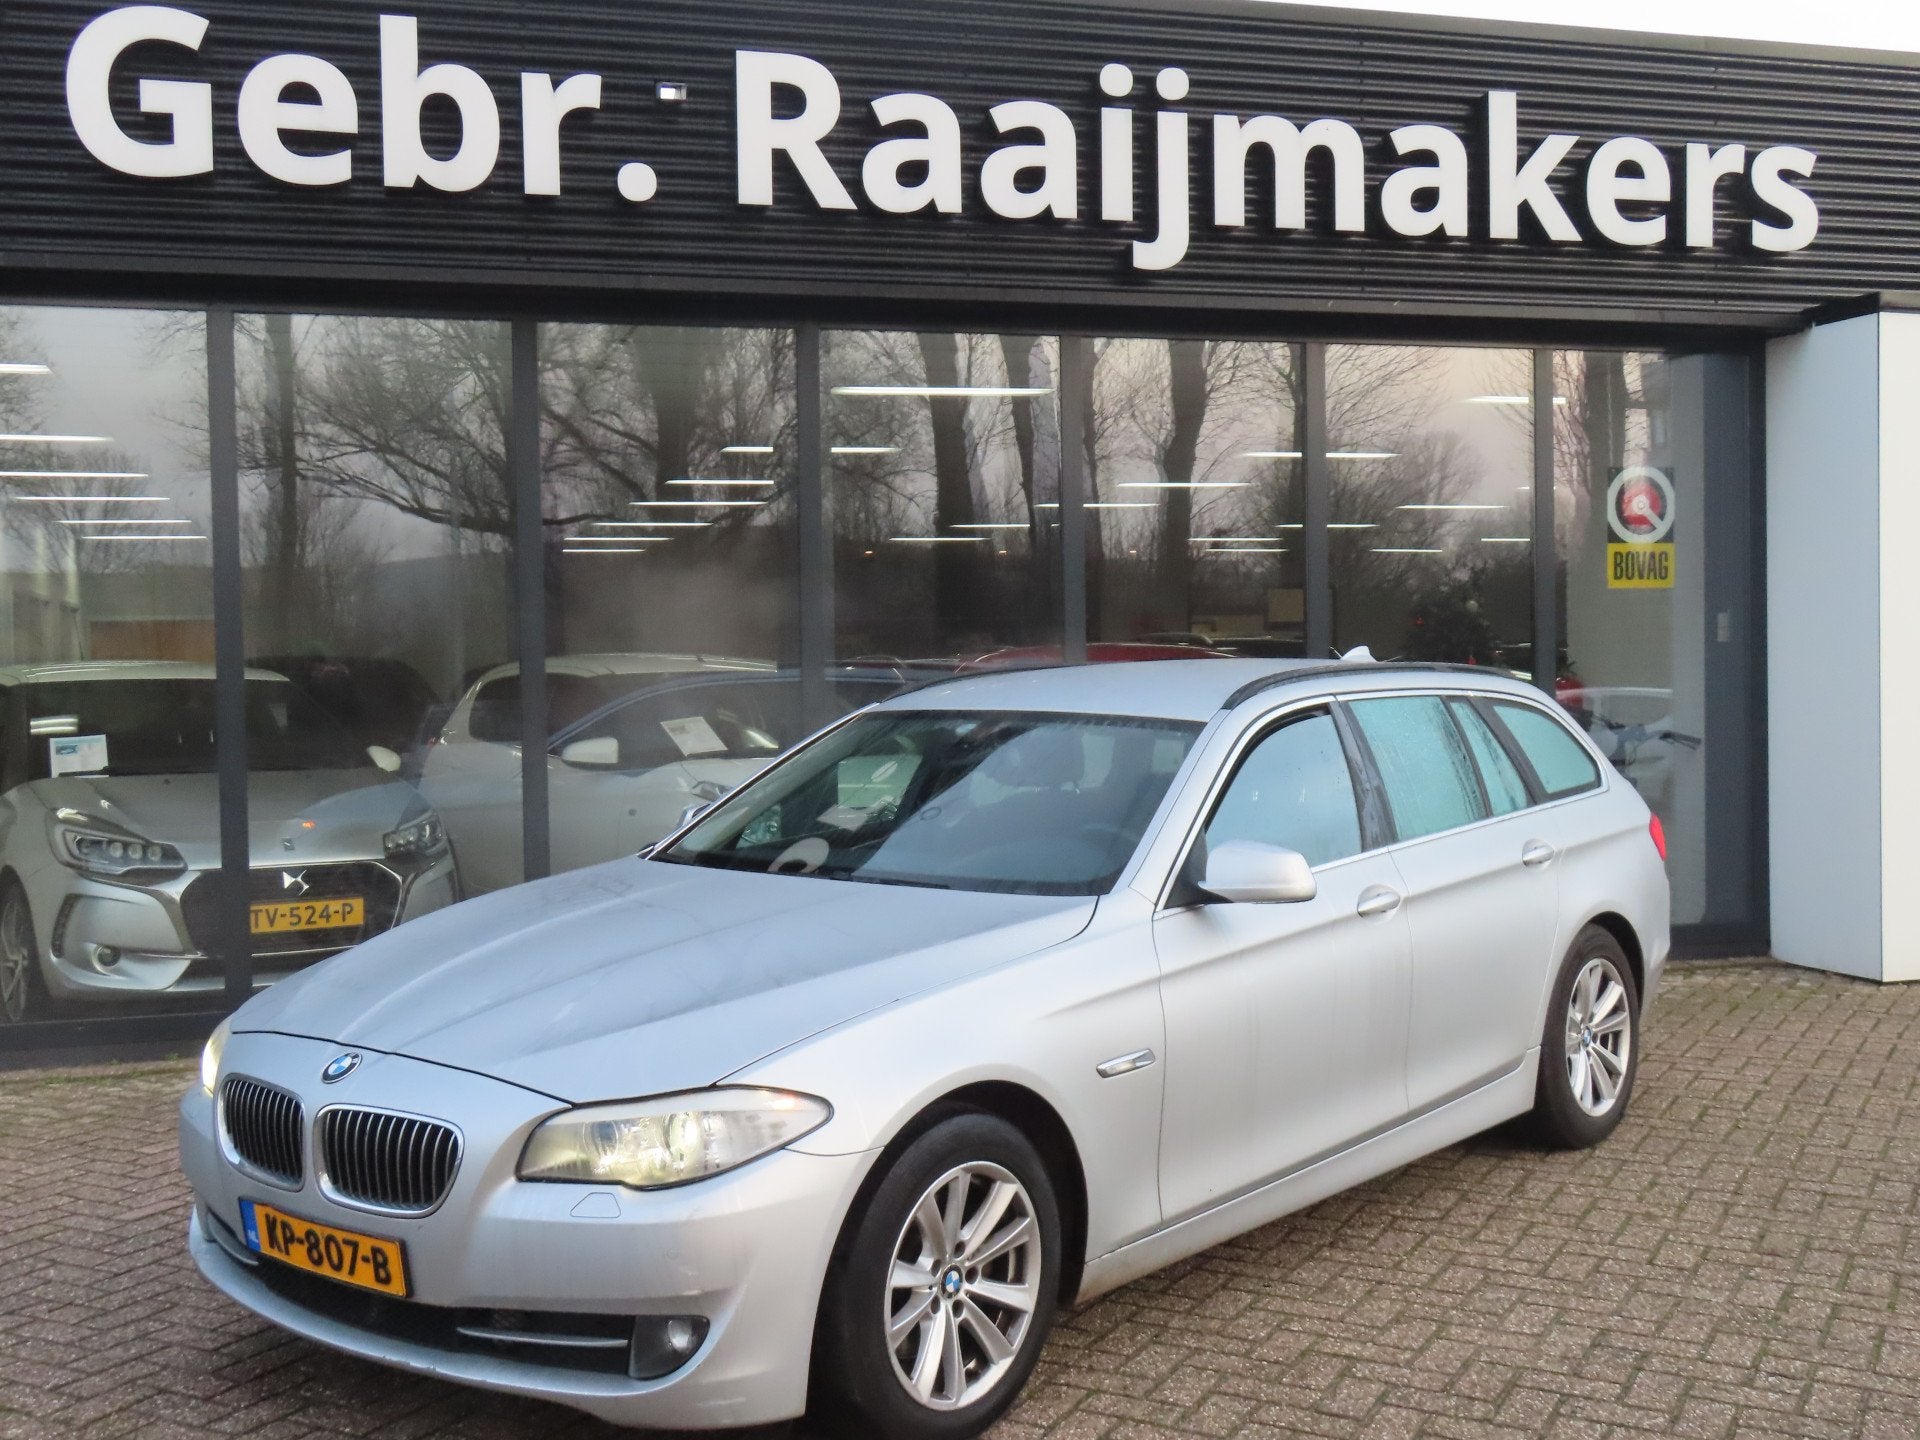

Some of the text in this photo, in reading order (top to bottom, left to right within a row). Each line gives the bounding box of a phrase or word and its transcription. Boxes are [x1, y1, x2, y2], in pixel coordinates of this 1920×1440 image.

[66, 5, 1819, 270] Gebr. Raaijmakers
[1613, 551, 1669, 581] BOVAG
[250, 902, 354, 929] TV-524-P
[265, 1213, 392, 1285] KP-807-B
